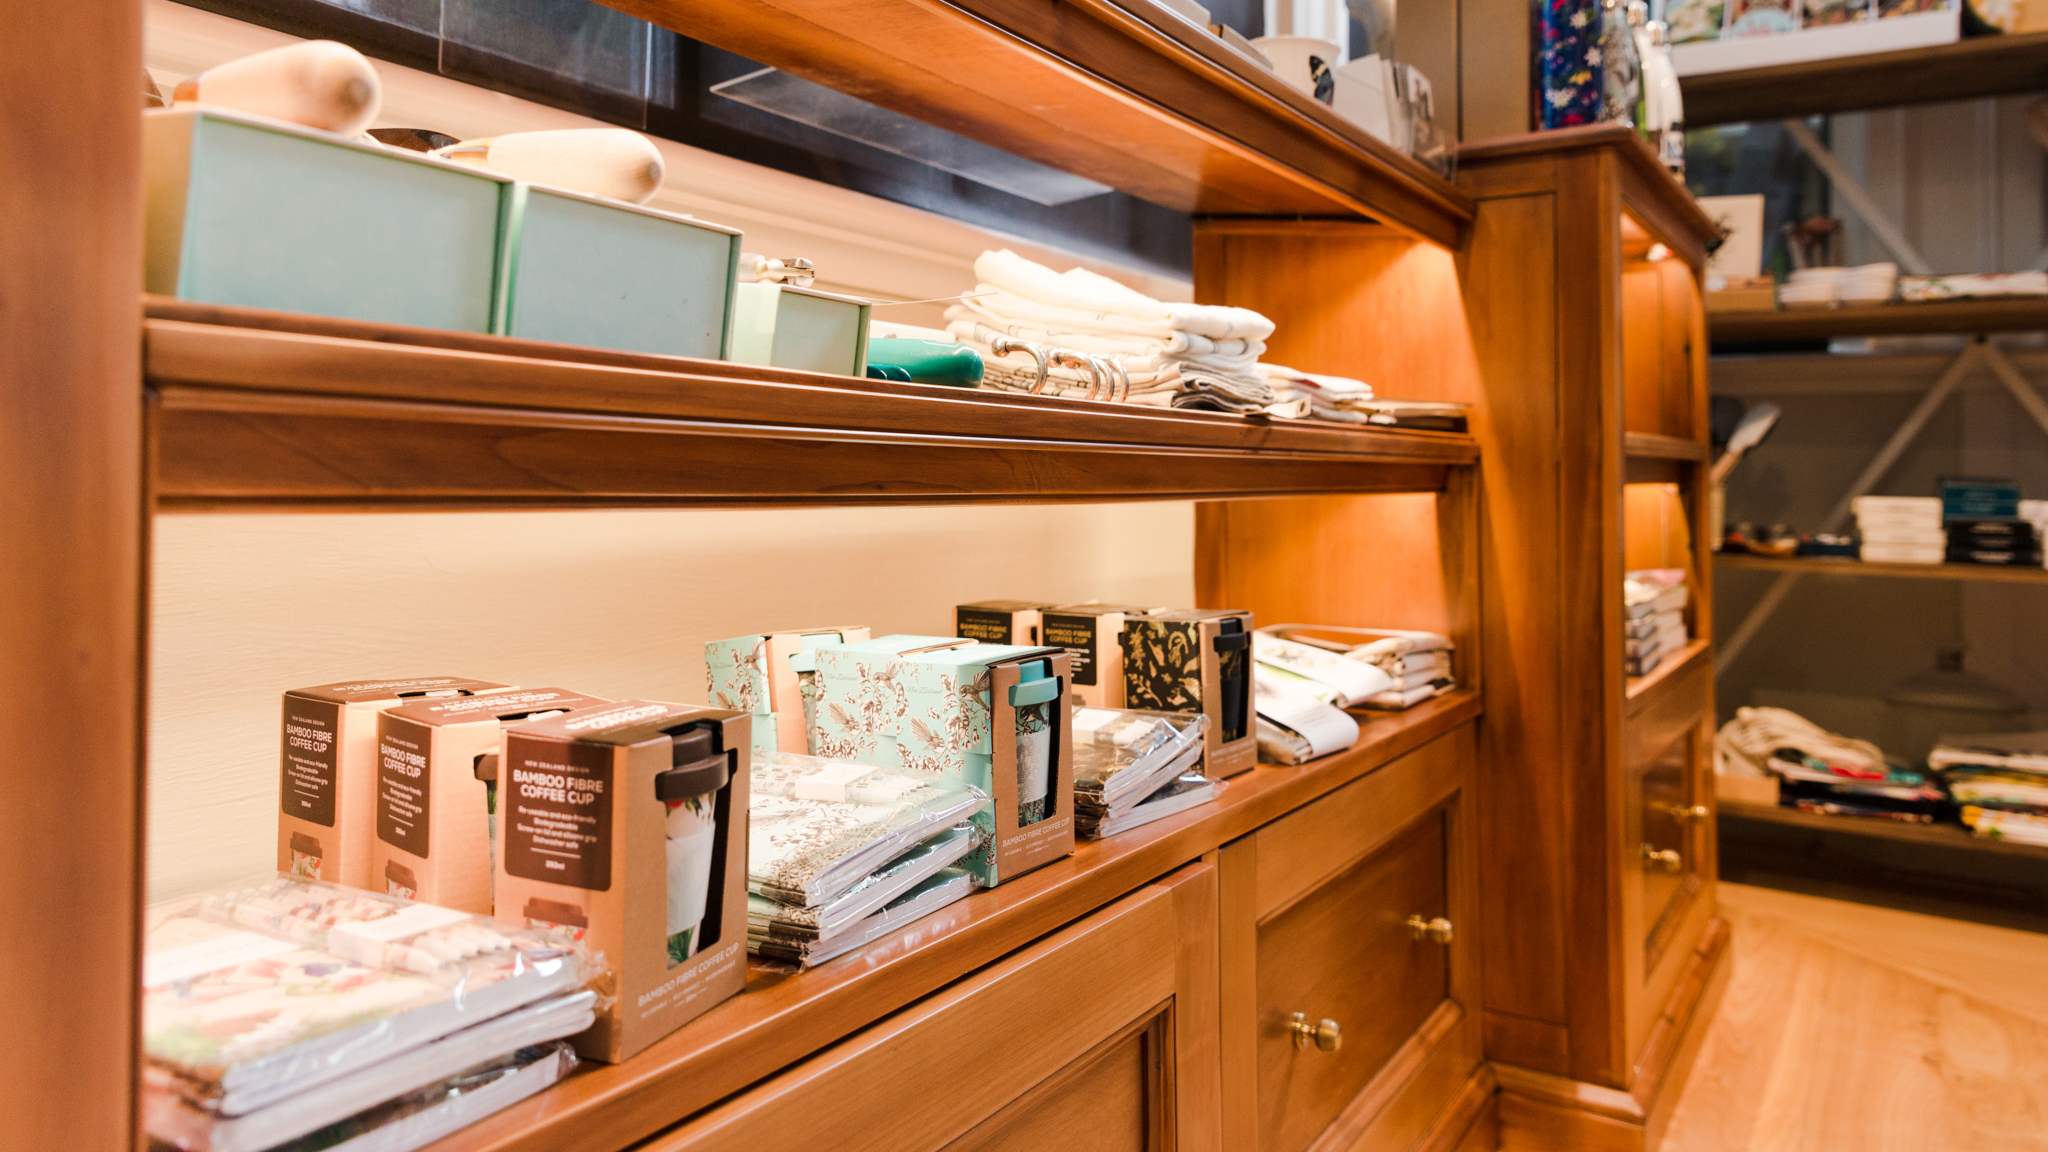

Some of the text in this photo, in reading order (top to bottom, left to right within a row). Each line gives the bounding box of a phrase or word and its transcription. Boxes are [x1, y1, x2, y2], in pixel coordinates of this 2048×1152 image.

[286, 724, 332, 743] BAMBOO FIBRE
[290, 736, 327, 753] COFFEE CUP
[381, 744, 426, 768] BAMBOO FIBRE
[384, 757, 421, 778] COFFEE CUP
[539, 761, 566, 772] ZEALAND
[566, 765, 590, 774] DESIGN
[513, 769, 603, 794] BAMBOO FIBRE
[520, 784, 595, 805] COFFEE CUP
[1003, 834, 1026, 848] BAMBOO
[1028, 828, 1042, 839] FIBRE
[1043, 821, 1060, 834] COFFEE
[1061, 817, 1070, 827] CUP
[638, 979, 675, 1007] BAMBOO
[676, 966, 697, 985] FIBRE
[698, 950, 725, 973] COFFEE
[725, 942, 739, 957] CUP
